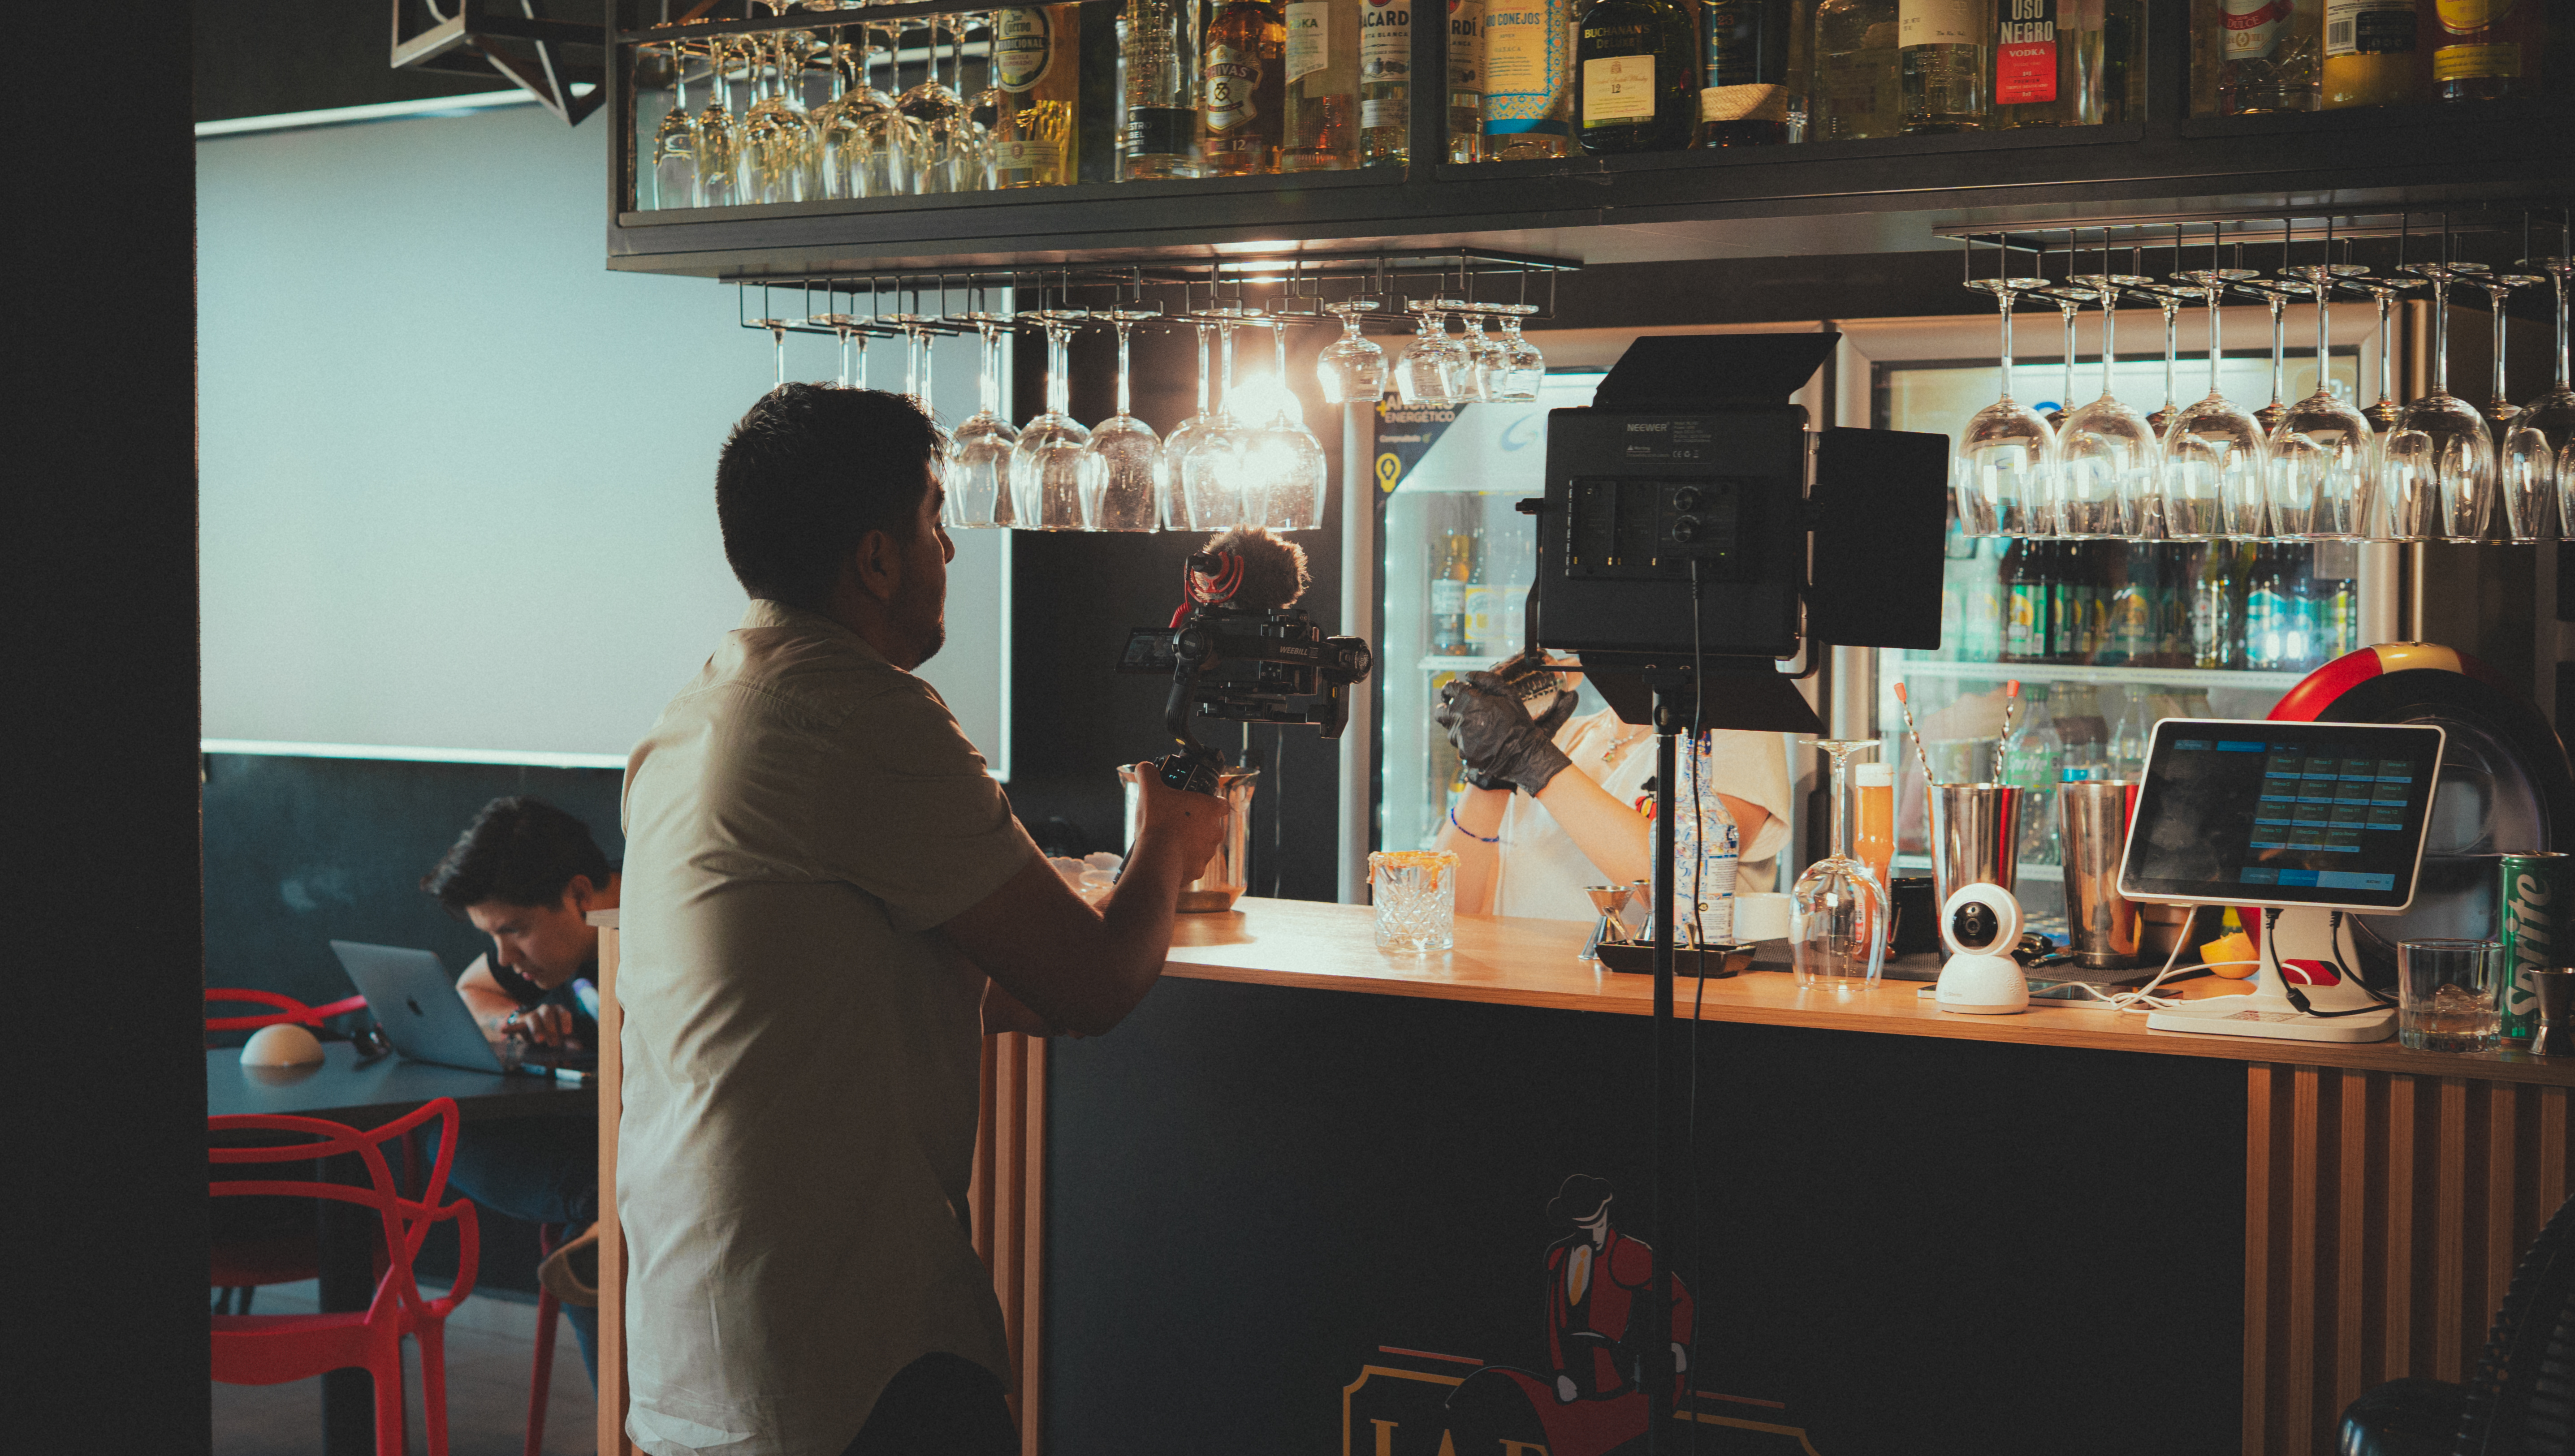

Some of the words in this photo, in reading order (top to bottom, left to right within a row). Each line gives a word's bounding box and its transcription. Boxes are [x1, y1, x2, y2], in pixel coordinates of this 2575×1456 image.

[1498, 13, 1540, 26] CONEJOS
[1717, 15, 1734, 26] 23
[2227, 15, 2260, 29] DULCE
[1584, 25, 1650, 39] BUCHANAN'S
[2000, 21, 2054, 44] NEGRO
[2009, 48, 2045, 57] VODKA
[1612, 84, 1621, 94] 12
[1232, 139, 1246, 151] 12
[1385, 410, 1456, 423] ENERGÉTICO
[1626, 423, 1667, 432] NEEWER
[1279, 646, 1308, 656] WEEBILL
[2009, 755, 2047, 774] Sprite
[2505, 874, 2552, 1016] Sprite
